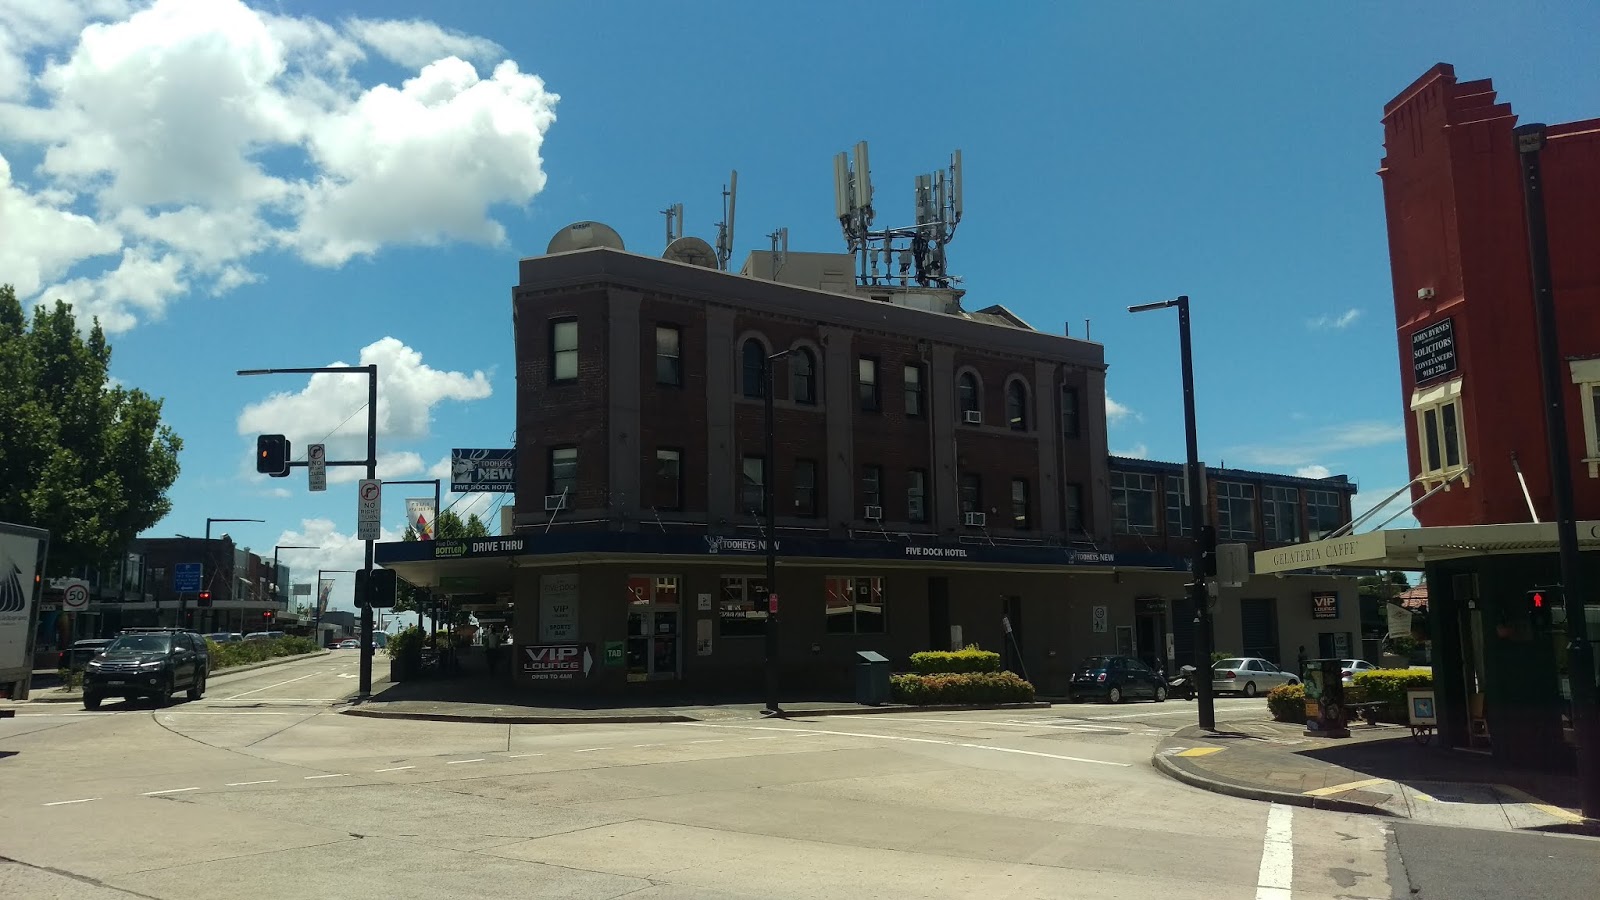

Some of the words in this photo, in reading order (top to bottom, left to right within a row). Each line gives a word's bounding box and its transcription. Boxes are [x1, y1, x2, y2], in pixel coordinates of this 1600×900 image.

[1413, 331, 1428, 344] JOHN
[1428, 322, 1450, 337] BYRNES
[1414, 337, 1451, 359] SOLICITORS
[1415, 351, 1453, 370] CONVEYANCERS
[477, 467, 514, 480] NEW
[472, 541, 498, 553] DRIVE
[500, 539, 524, 551] THRU
[723, 540, 756, 549] TOOHEYS
[758, 540, 780, 550] NW
[905, 547, 921, 555] FIVE
[923, 547, 944, 556] DOCK
[944, 548, 968, 557] HOTEL
[1100, 553, 1115, 562] NEW
[1273, 548, 1321, 566] GELATERIA
[69, 590, 84, 601] 50
[1314, 598, 1336, 606] VIP
[552, 605, 569, 613] VIP
[525, 648, 578, 661] VIP
[607, 649, 622, 657] TAB
[524, 661, 579, 670] LOUNGE
